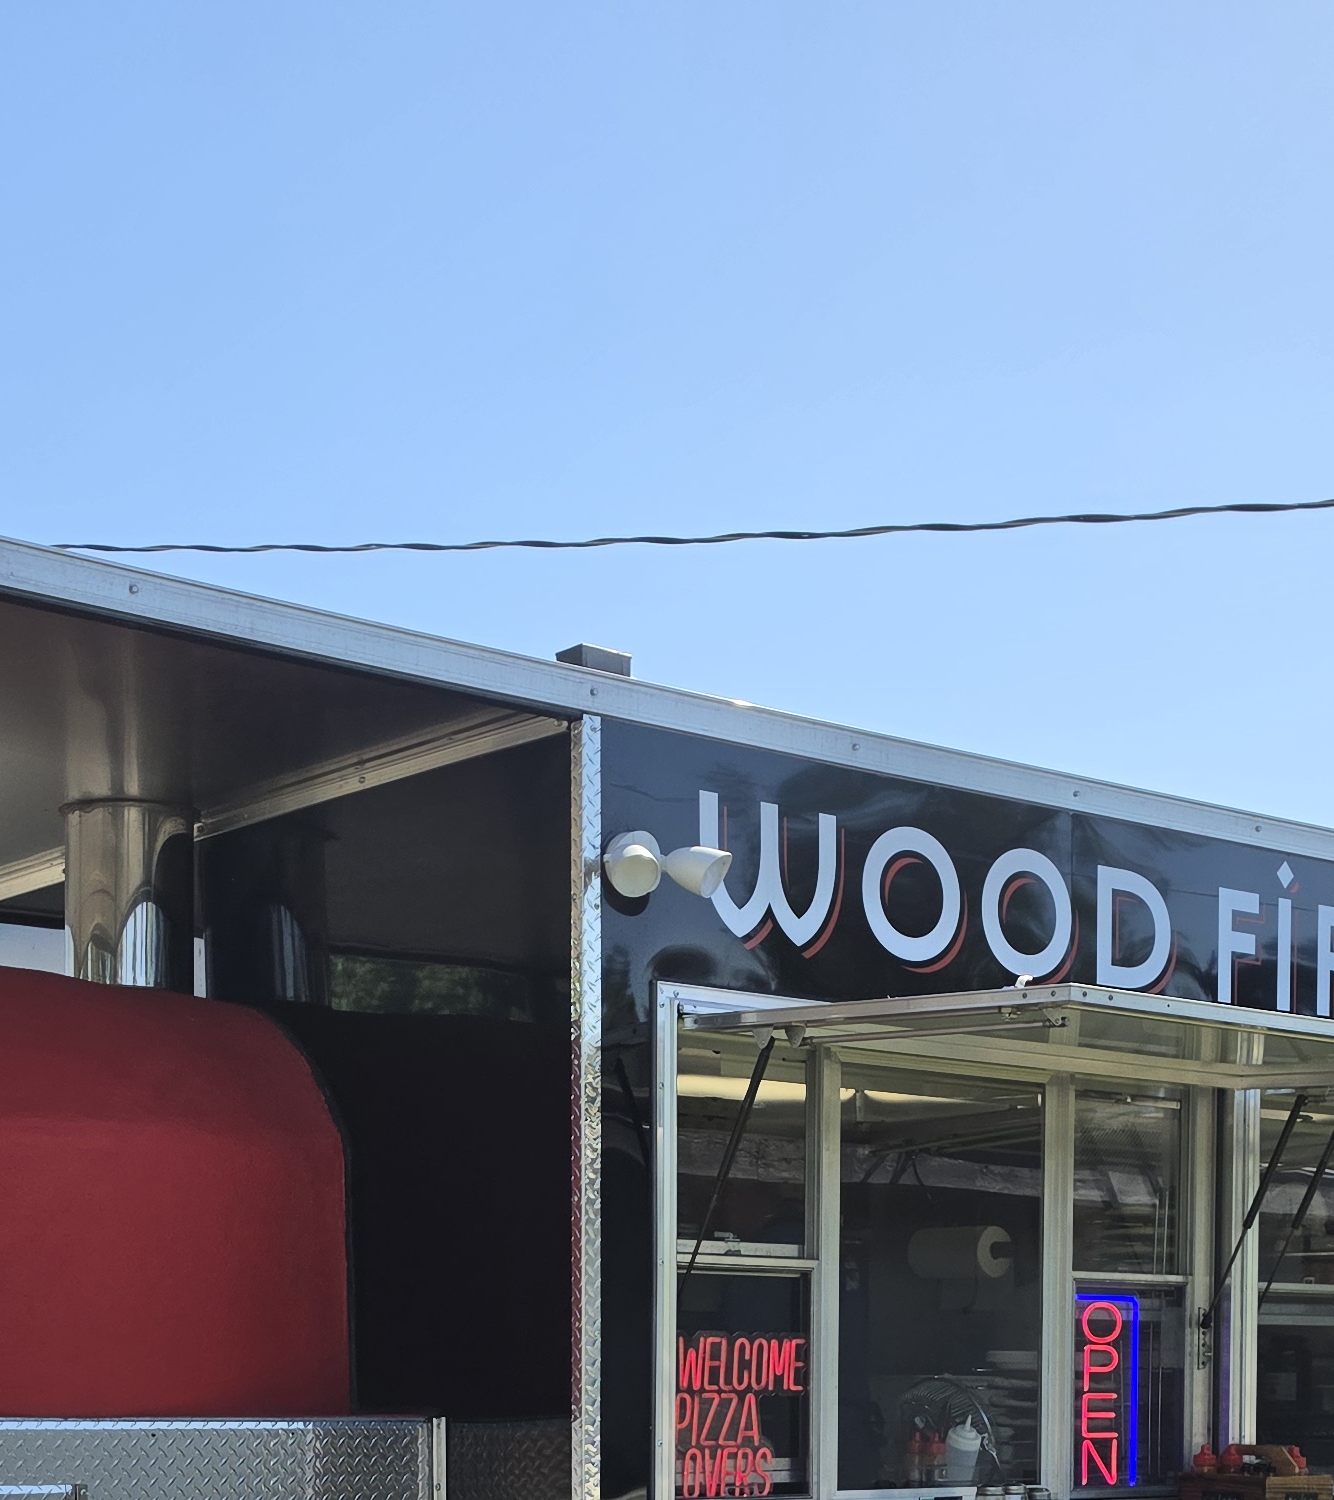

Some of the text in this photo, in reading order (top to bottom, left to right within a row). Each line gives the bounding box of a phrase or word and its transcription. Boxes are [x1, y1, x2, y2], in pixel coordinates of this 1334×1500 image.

[699, 789, 1173, 990] WOOD
[678, 1336, 806, 1391] WELCOME
[676, 1392, 759, 1446] PIZZA
[1082, 1301, 1122, 1486] OPEN
[683, 1447, 773, 1498] OVERS
